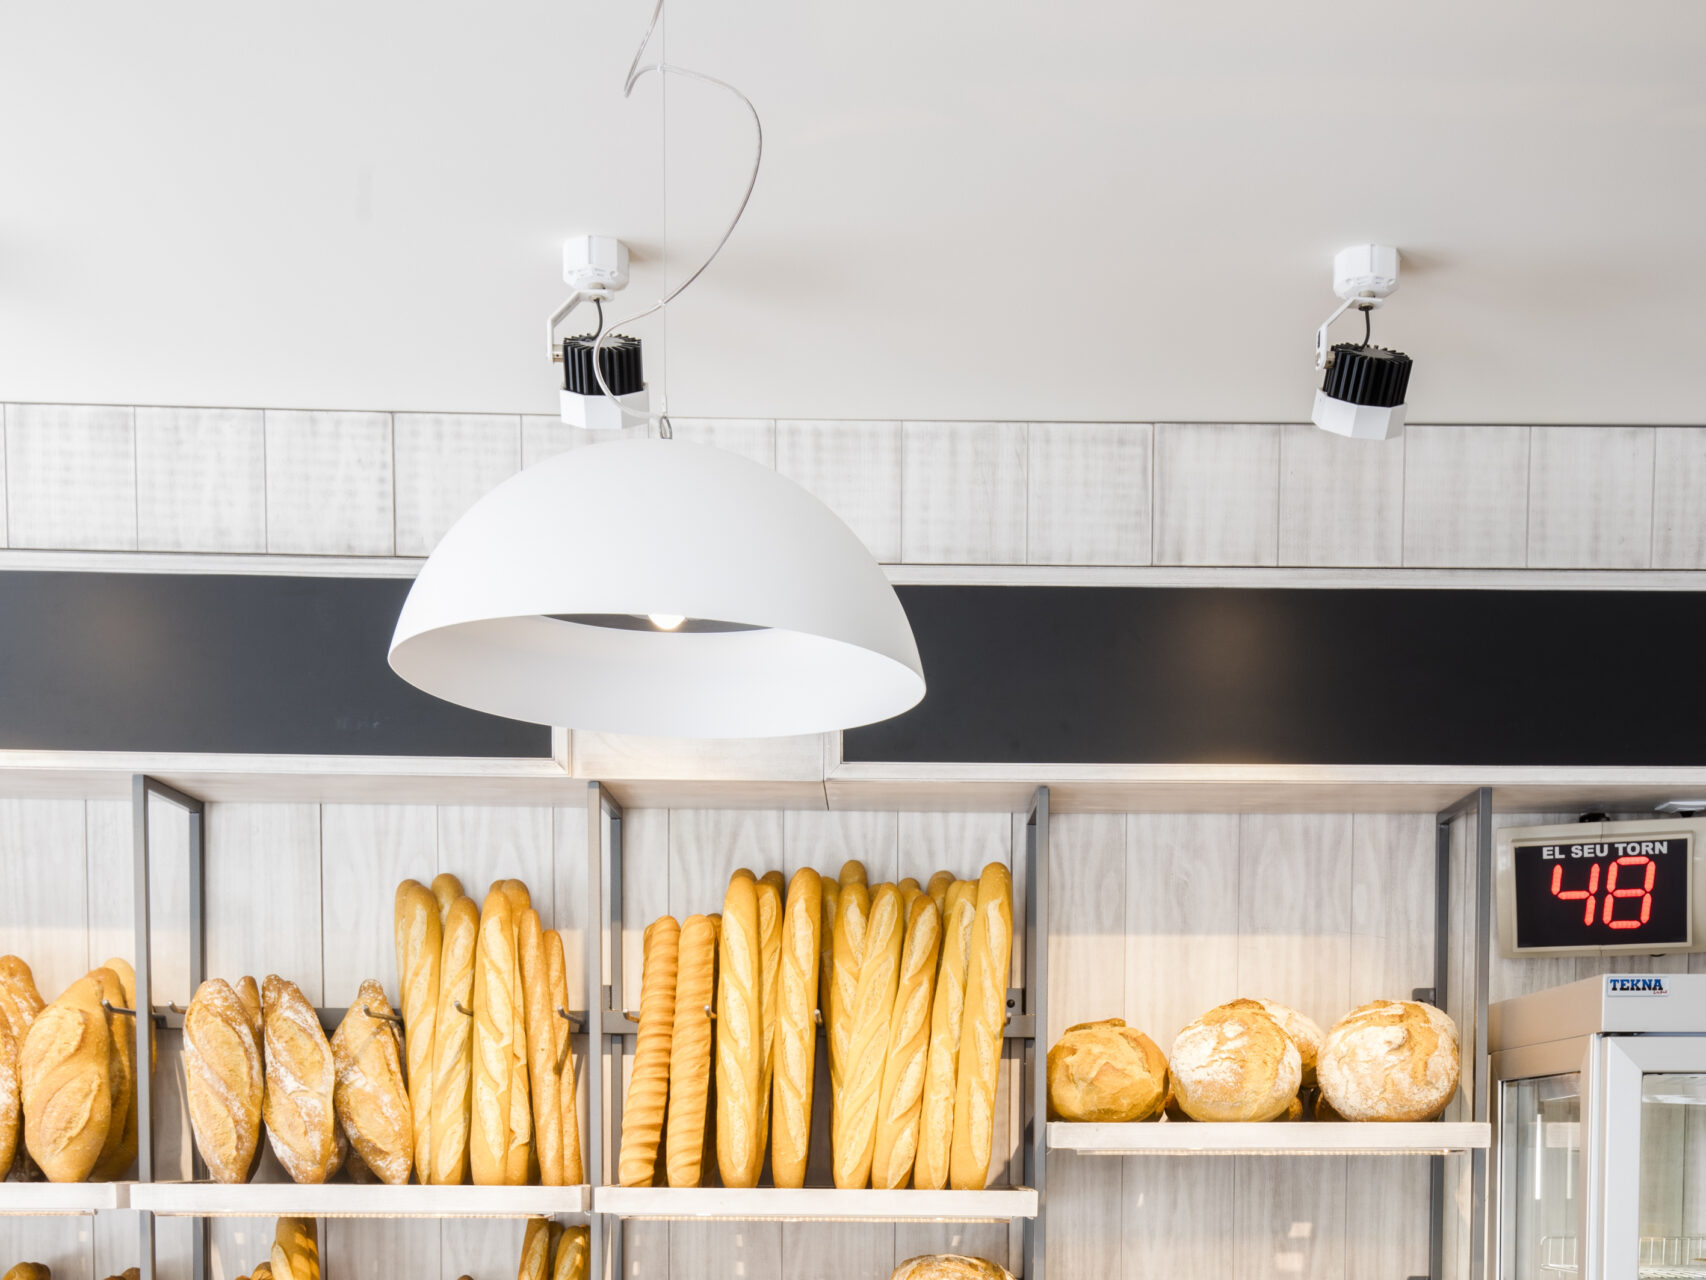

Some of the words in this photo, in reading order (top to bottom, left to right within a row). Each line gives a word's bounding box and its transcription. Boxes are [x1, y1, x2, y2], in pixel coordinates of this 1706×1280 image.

[1542, 846, 1565, 859] EL
[1571, 844, 1609, 858] SEU
[1614, 841, 1668, 856] TORN
[1551, 856, 1656, 929] 48
[1610, 979, 1663, 991] TEKNA
